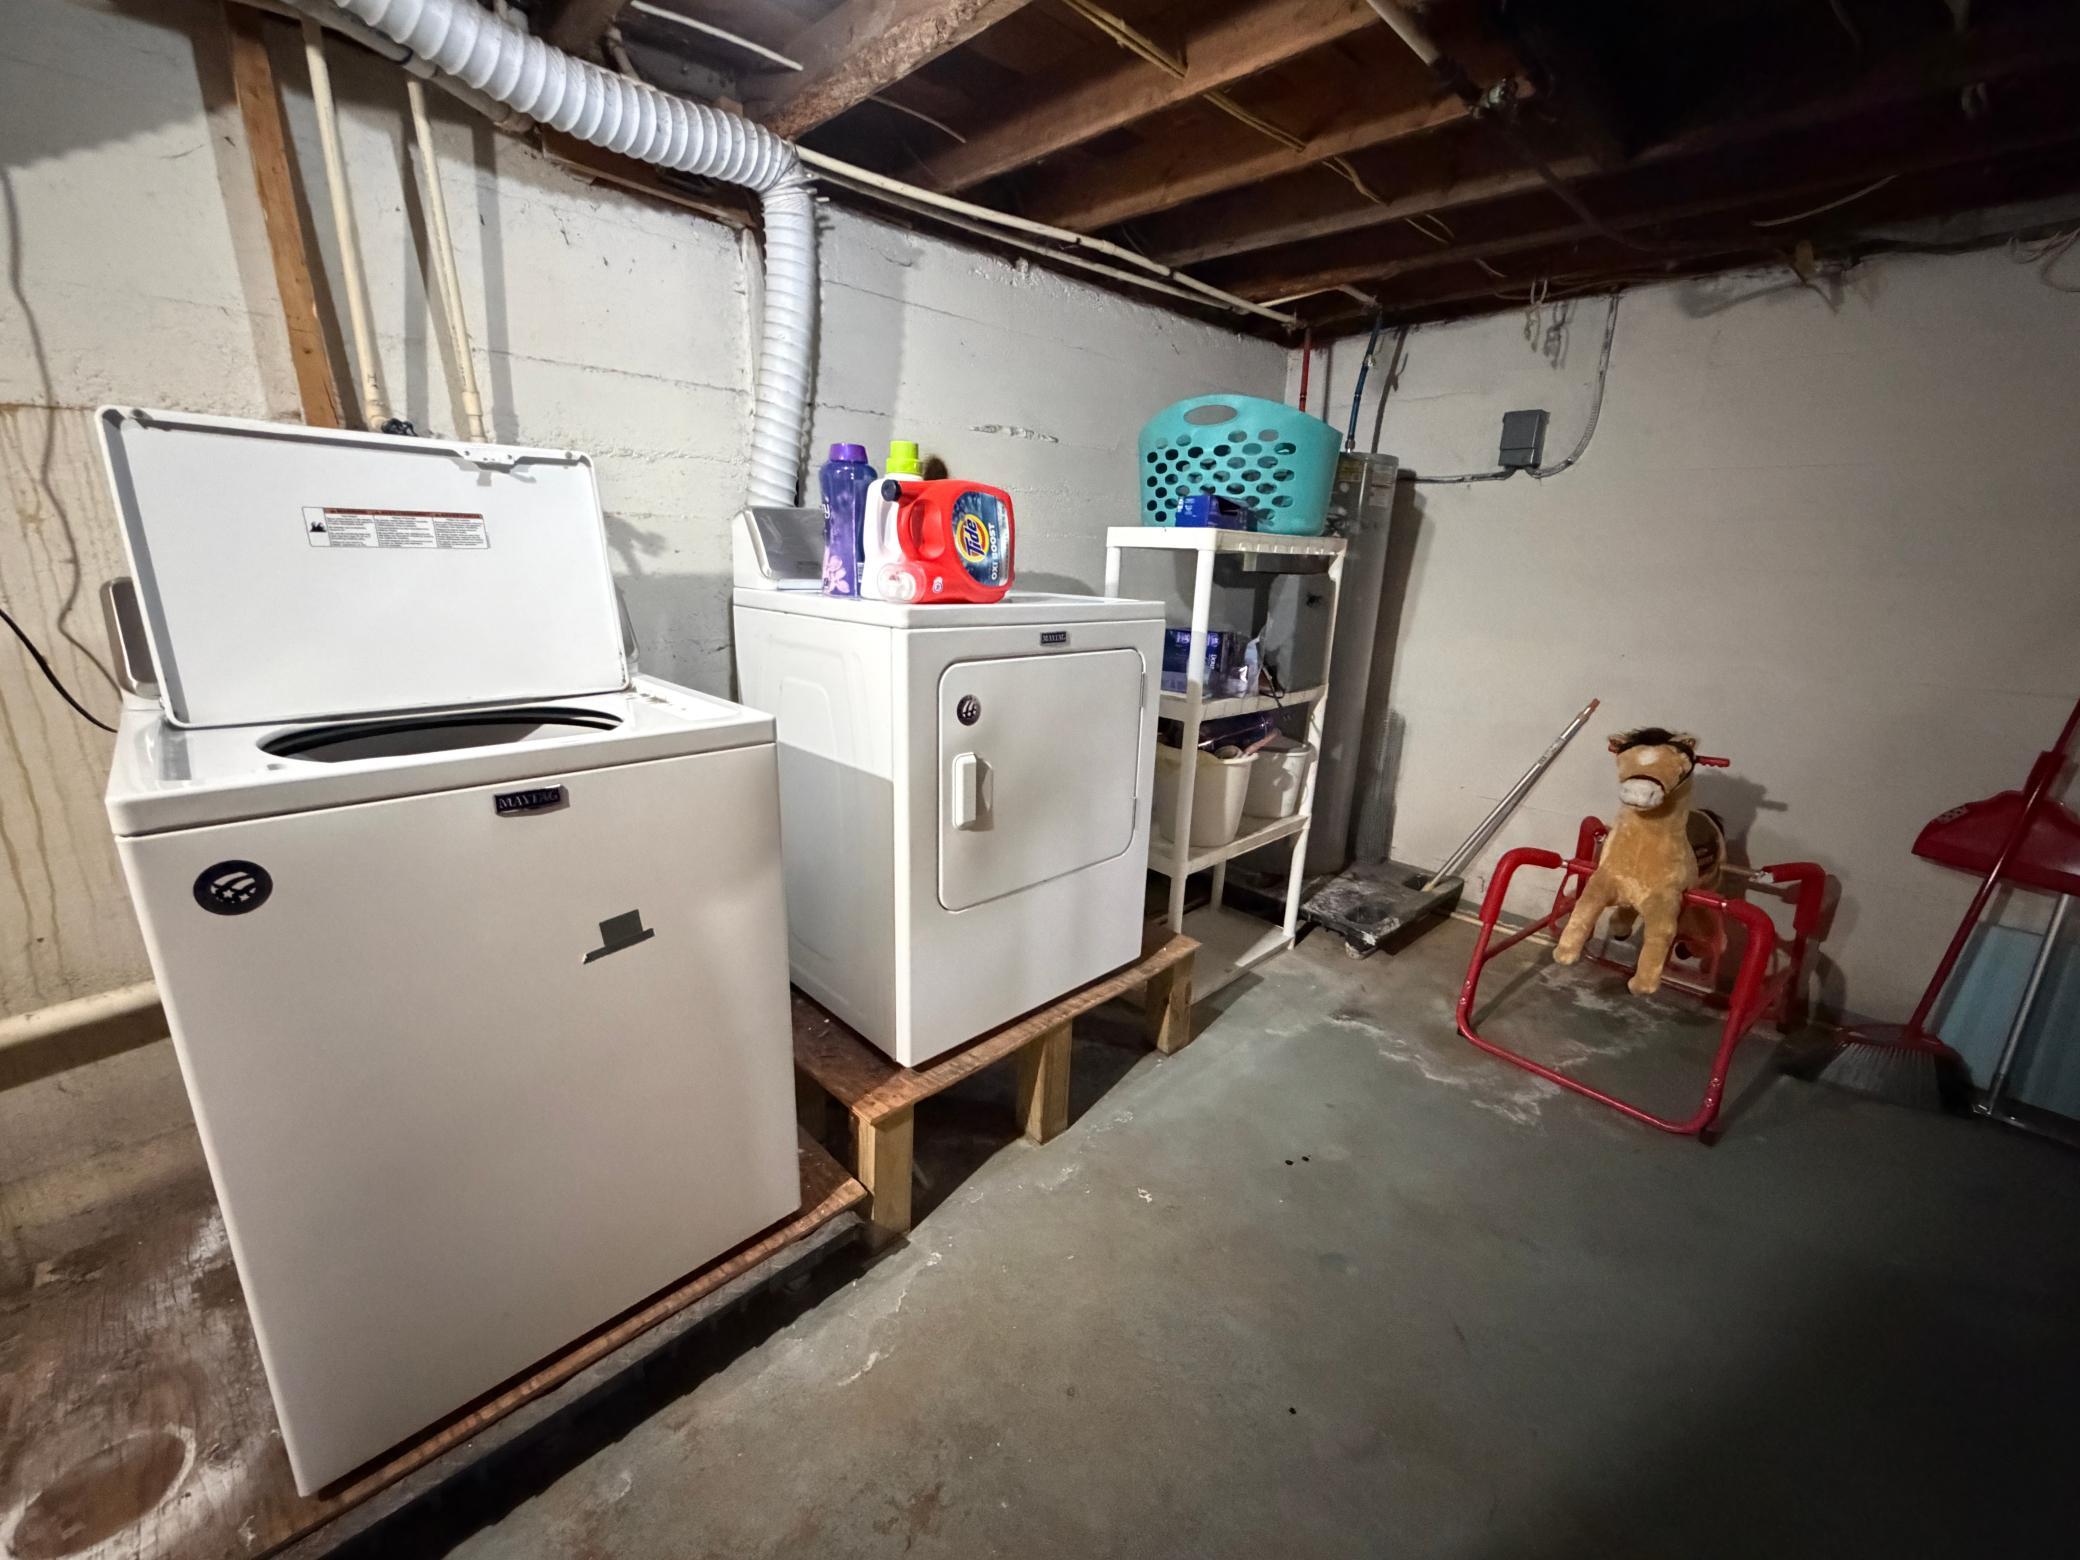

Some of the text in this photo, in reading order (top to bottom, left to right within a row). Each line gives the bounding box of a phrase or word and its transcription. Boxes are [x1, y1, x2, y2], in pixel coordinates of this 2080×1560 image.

[964, 518, 985, 556] Tide
[988, 522, 999, 581] OXI BOOST
[498, 790, 558, 809] MAYTAG
